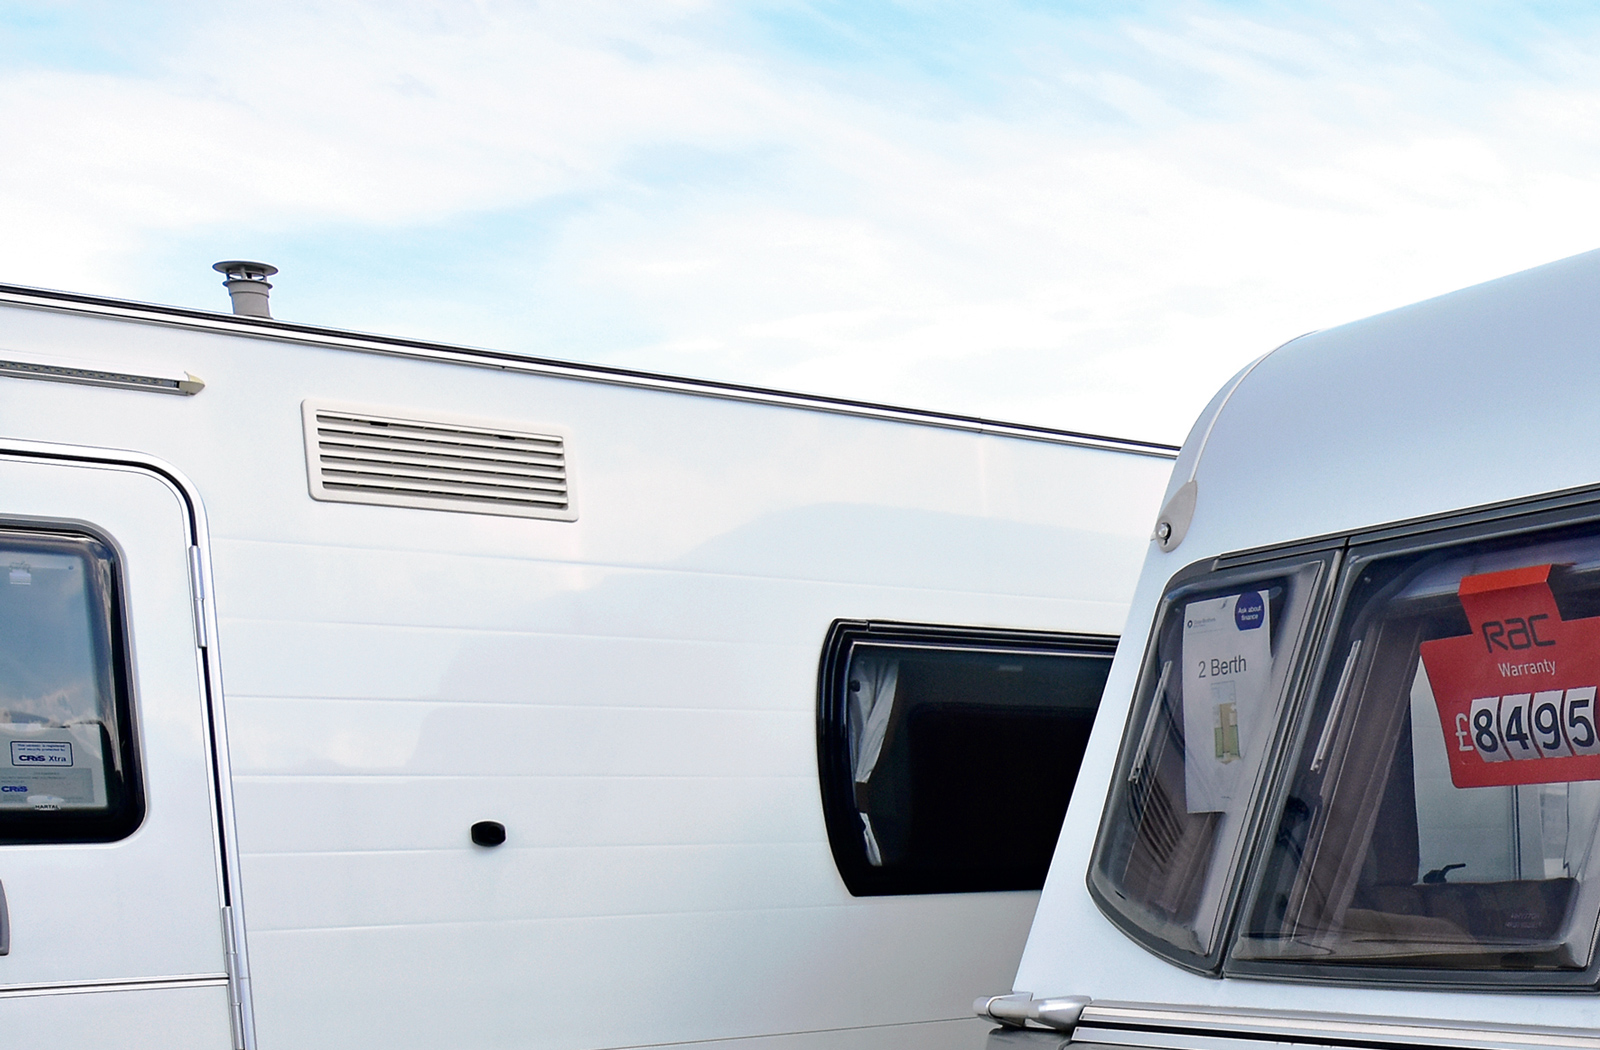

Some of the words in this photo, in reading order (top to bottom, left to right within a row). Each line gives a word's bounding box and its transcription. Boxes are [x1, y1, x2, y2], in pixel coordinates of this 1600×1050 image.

[1248, 605, 1262, 613] about
[1198, 660, 1206, 679] 2
[1211, 654, 1247, 677] Berth
[1497, 658, 1556, 678] Warranty
[1455, 698, 1595, 753] £8495
